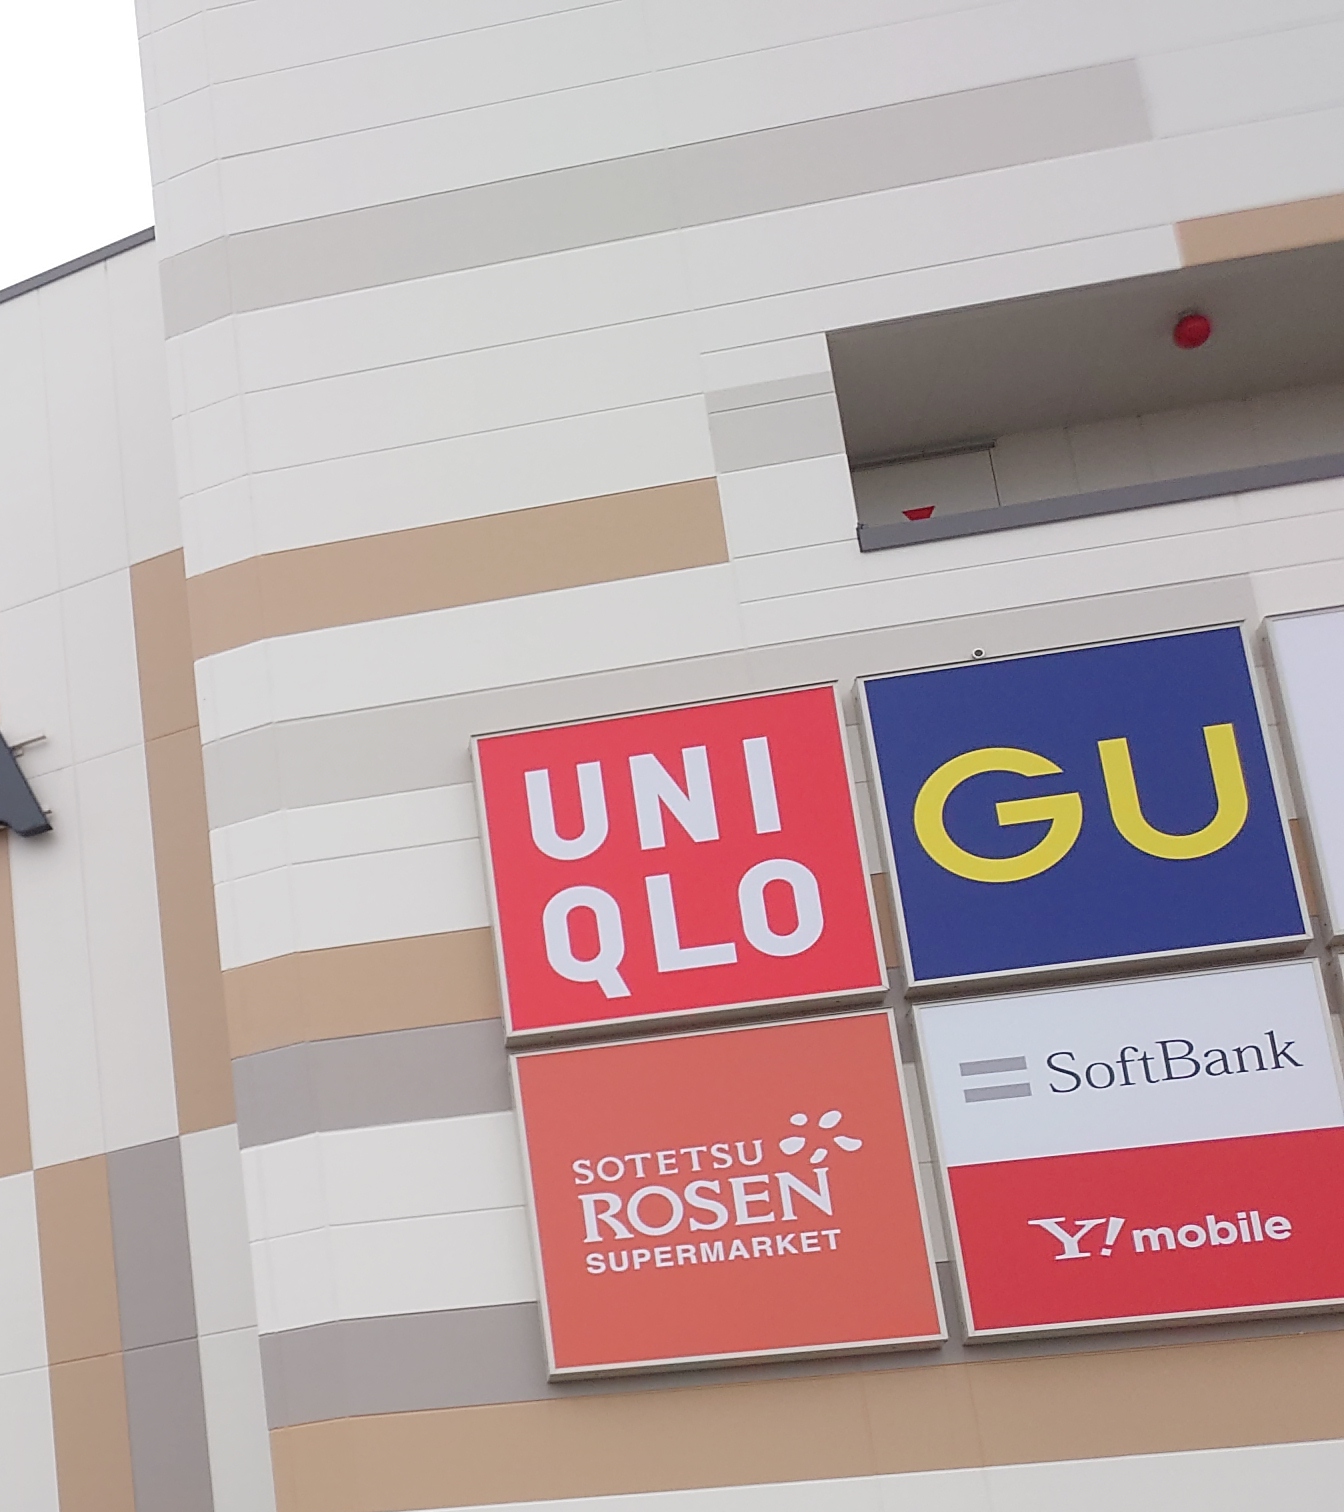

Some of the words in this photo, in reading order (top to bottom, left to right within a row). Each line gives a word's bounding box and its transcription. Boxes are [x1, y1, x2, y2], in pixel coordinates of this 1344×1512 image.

[524, 736, 783, 861] UNI
[914, 723, 1249, 883] GU
[542, 858, 825, 999] QLO
[1046, 1030, 1304, 1095] SoftBank
[572, 1139, 765, 1185] SOTETSU
[578, 1166, 835, 1243] ROSEN
[585, 1229, 842, 1275] SUPERMARKET
